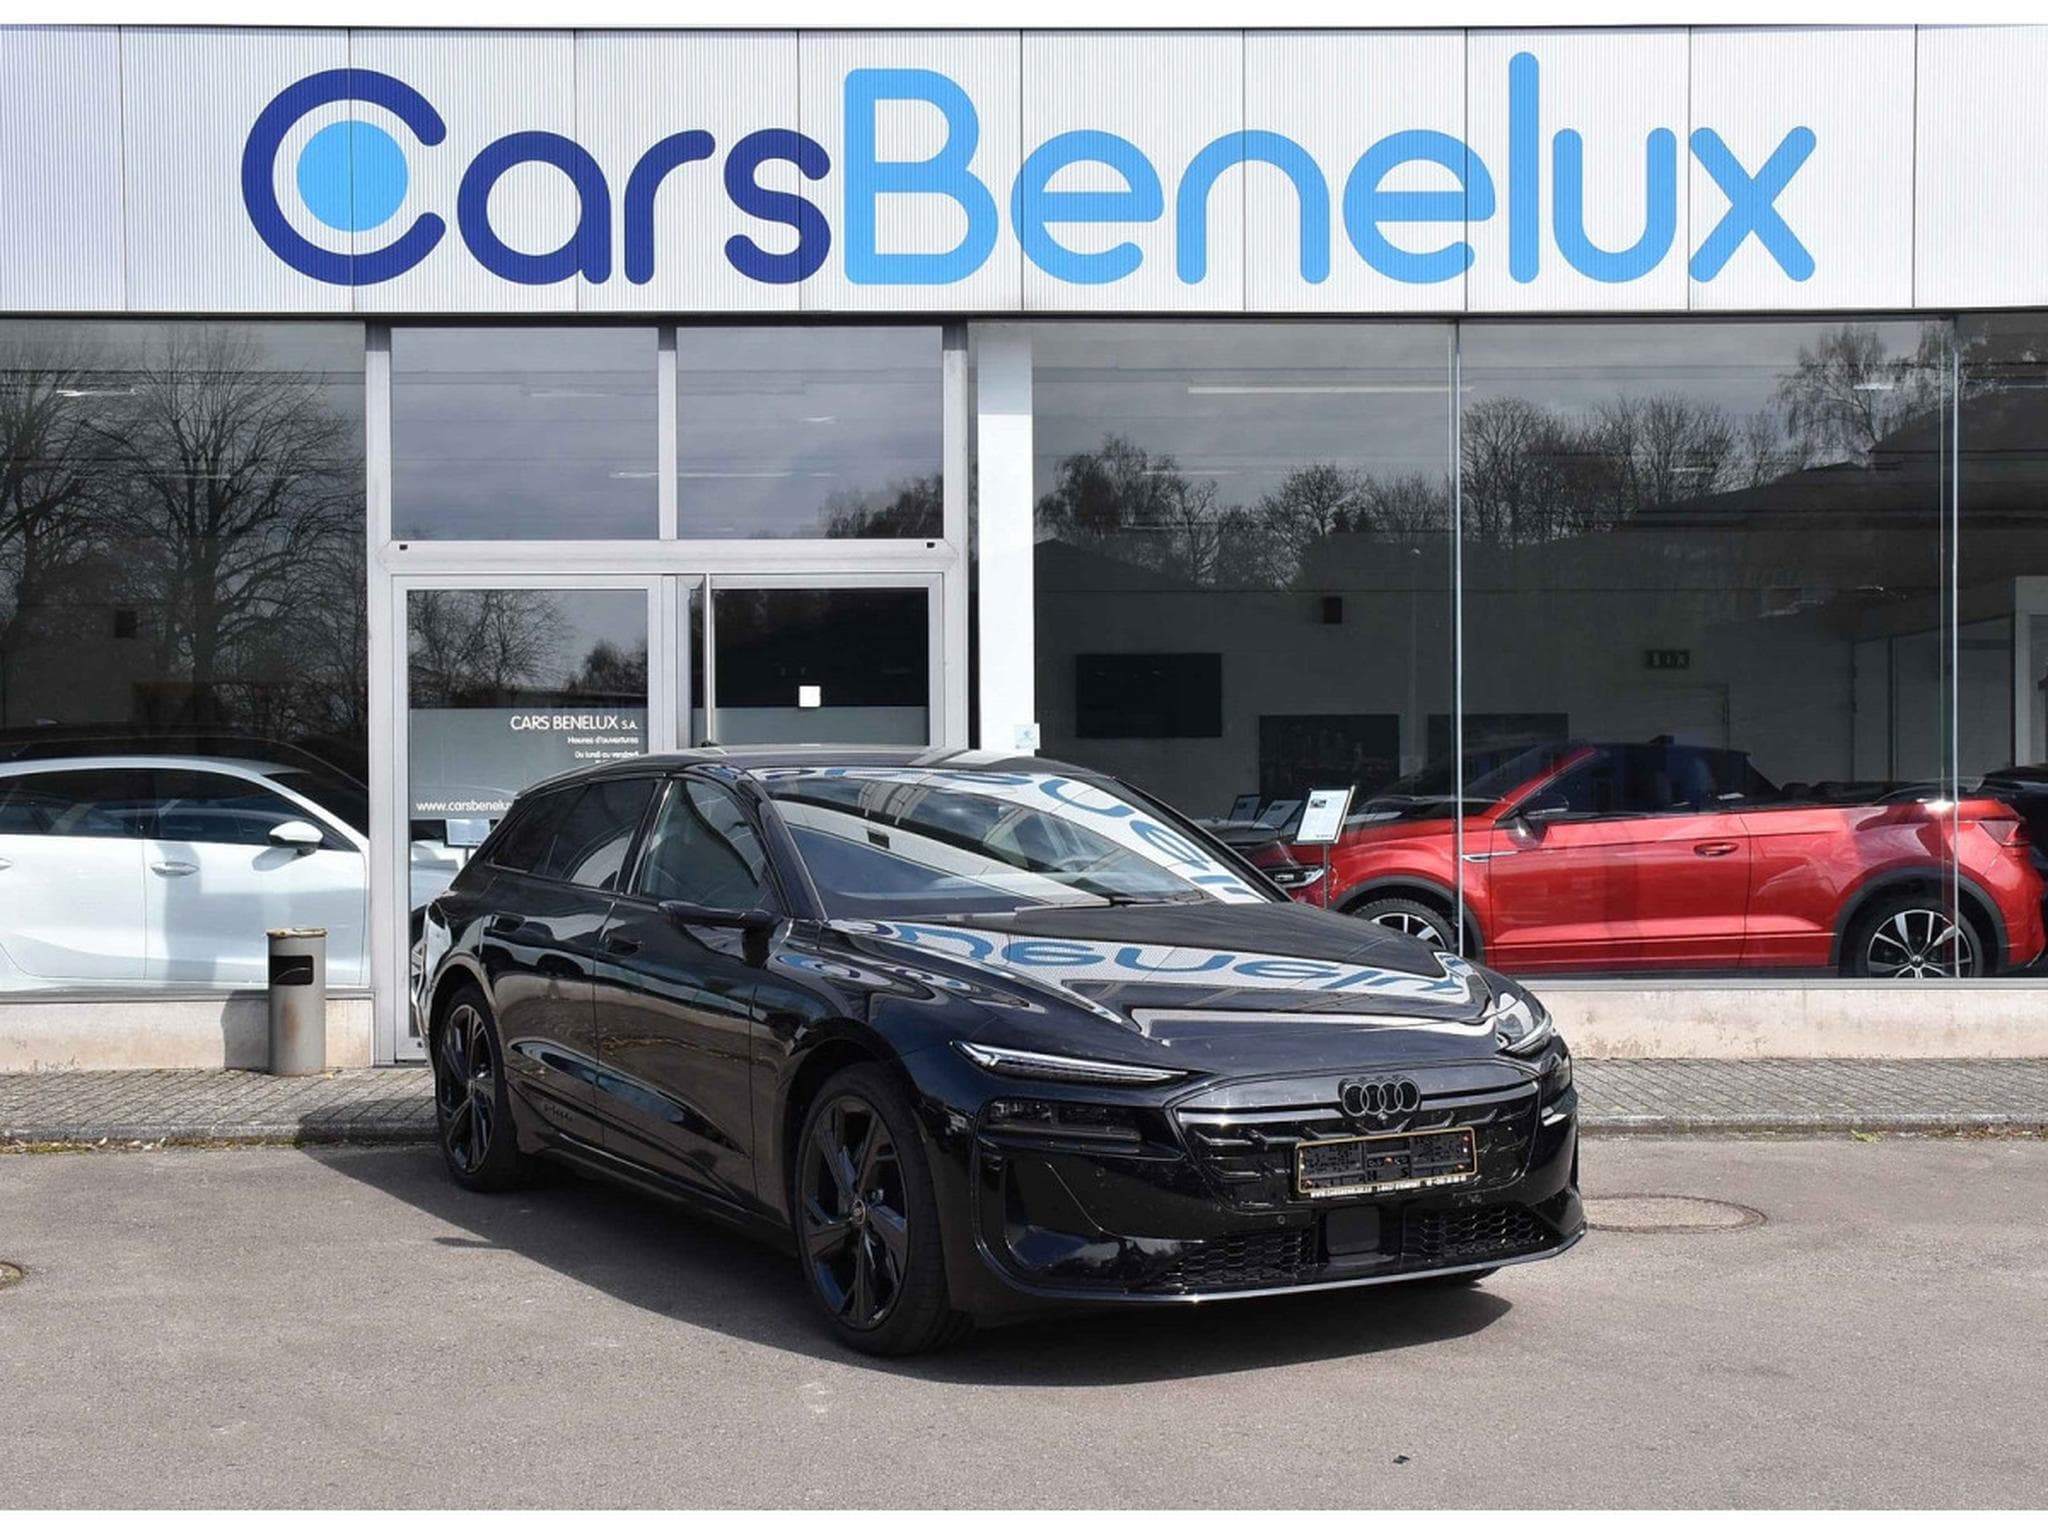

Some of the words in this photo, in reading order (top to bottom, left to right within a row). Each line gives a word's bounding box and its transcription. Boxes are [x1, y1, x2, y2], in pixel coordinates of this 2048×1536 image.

[242, 52, 1816, 285] CarsBenelux
[510, 715, 550, 730] CARS
[553, 715, 619, 730] BENELUX
[567, 736, 594, 745] Heures
